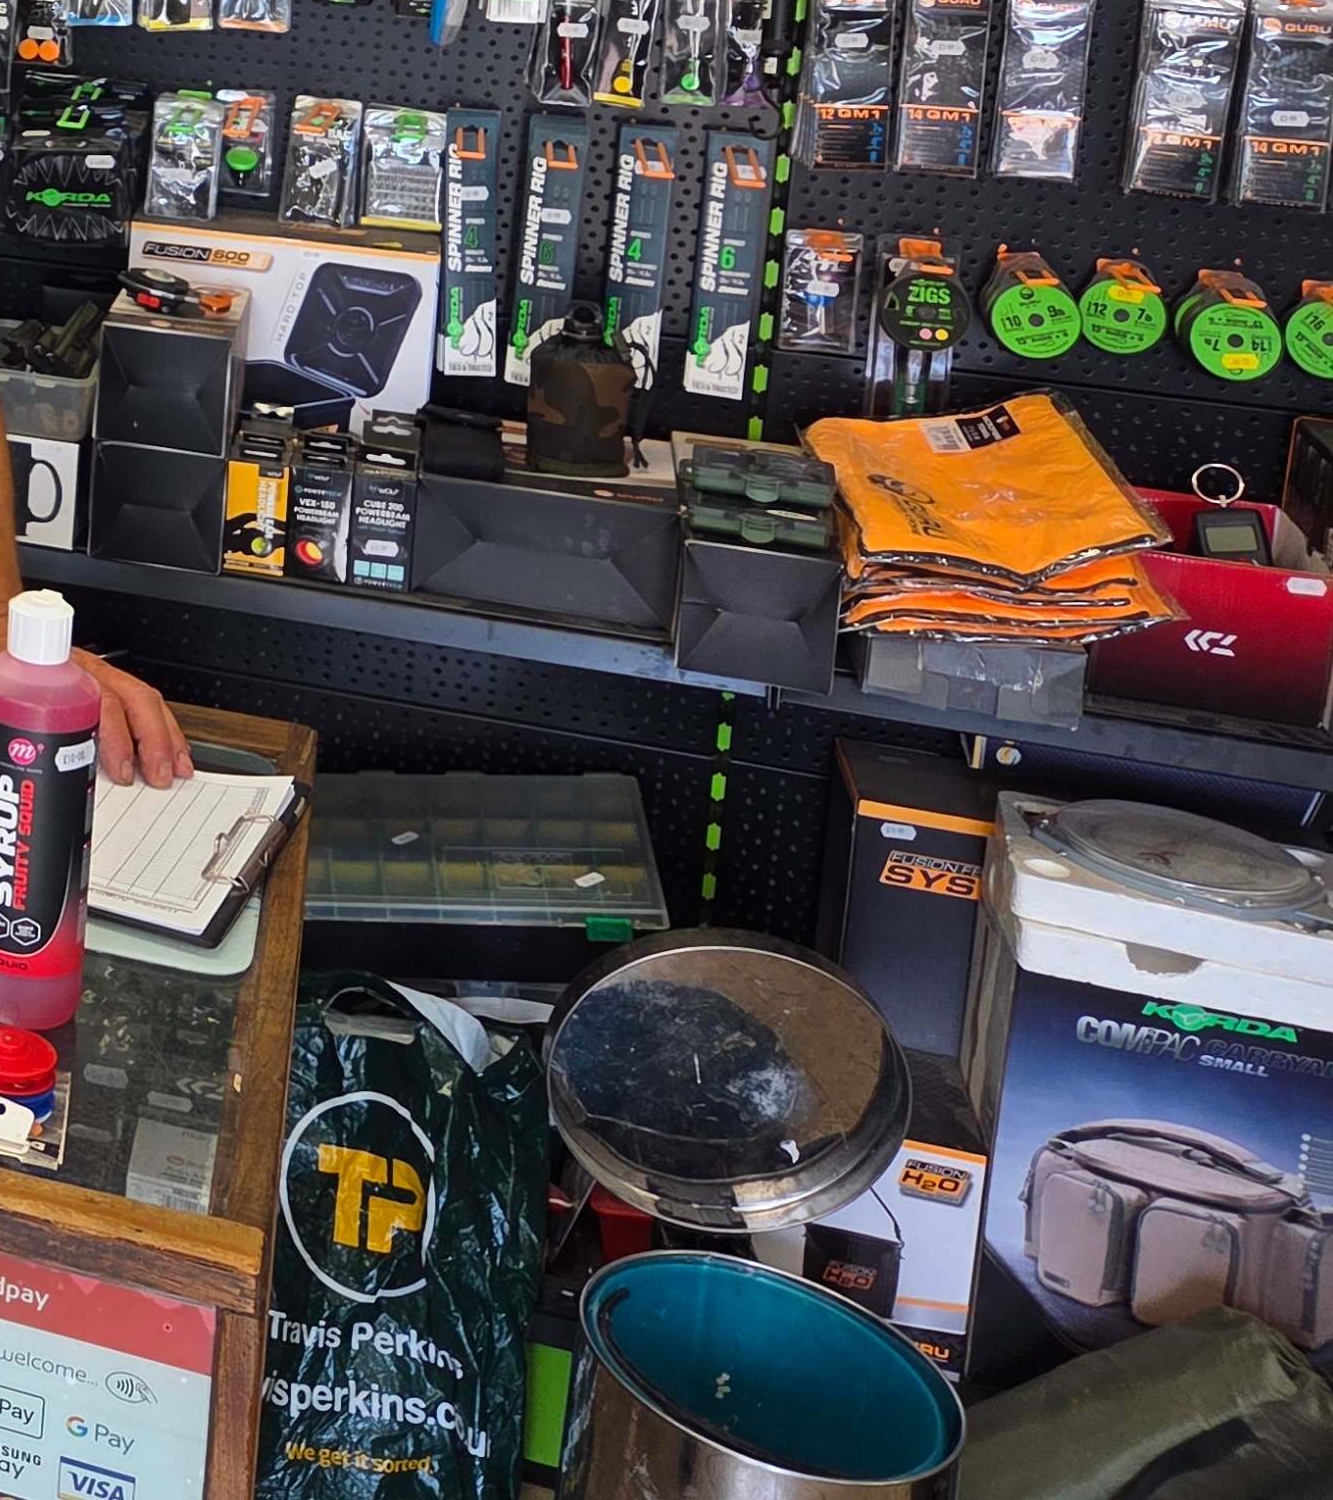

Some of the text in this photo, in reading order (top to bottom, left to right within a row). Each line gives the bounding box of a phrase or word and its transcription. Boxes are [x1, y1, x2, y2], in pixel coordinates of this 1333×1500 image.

[1284, 21, 1331, 33] GURU
[908, 108, 923, 120] 14
[26, 188, 111, 207] KORDA
[447, 143, 463, 272] SPINNER RIG
[519, 156, 548, 285] SPINNER RIG
[609, 154, 635, 282] SPINNER RIG
[700, 162, 728, 291] SPINNER RIG
[464, 224, 479, 248] 4
[144, 242, 251, 263] FUSION 600
[540, 241, 554, 263] 6
[627, 240, 641, 261] 4
[720, 246, 735, 269] 6
[908, 287, 950, 304] ZIGS
[1091, 303, 1107, 315] 12
[275, 304, 292, 343] HARD
[1006, 315, 1021, 327] 10
[358, 516, 406, 529] HEADLIGHT
[12, 779, 35, 912] FRUITY SQUID
[891, 851, 959, 874] FUSION
[884, 865, 977, 896] SYS
[1142, 1002, 1298, 1043] KORDA
[1199, 1054, 1269, 1077] SMALL
[906, 1159, 967, 1179] FUSION
[903, 1169, 959, 1196] H2O
[318, 1143, 424, 1254] TP
[268, 1309, 342, 1349] Travis
[95, 1423, 135, 1455] Pay
[285, 1441, 349, 1468] We get
